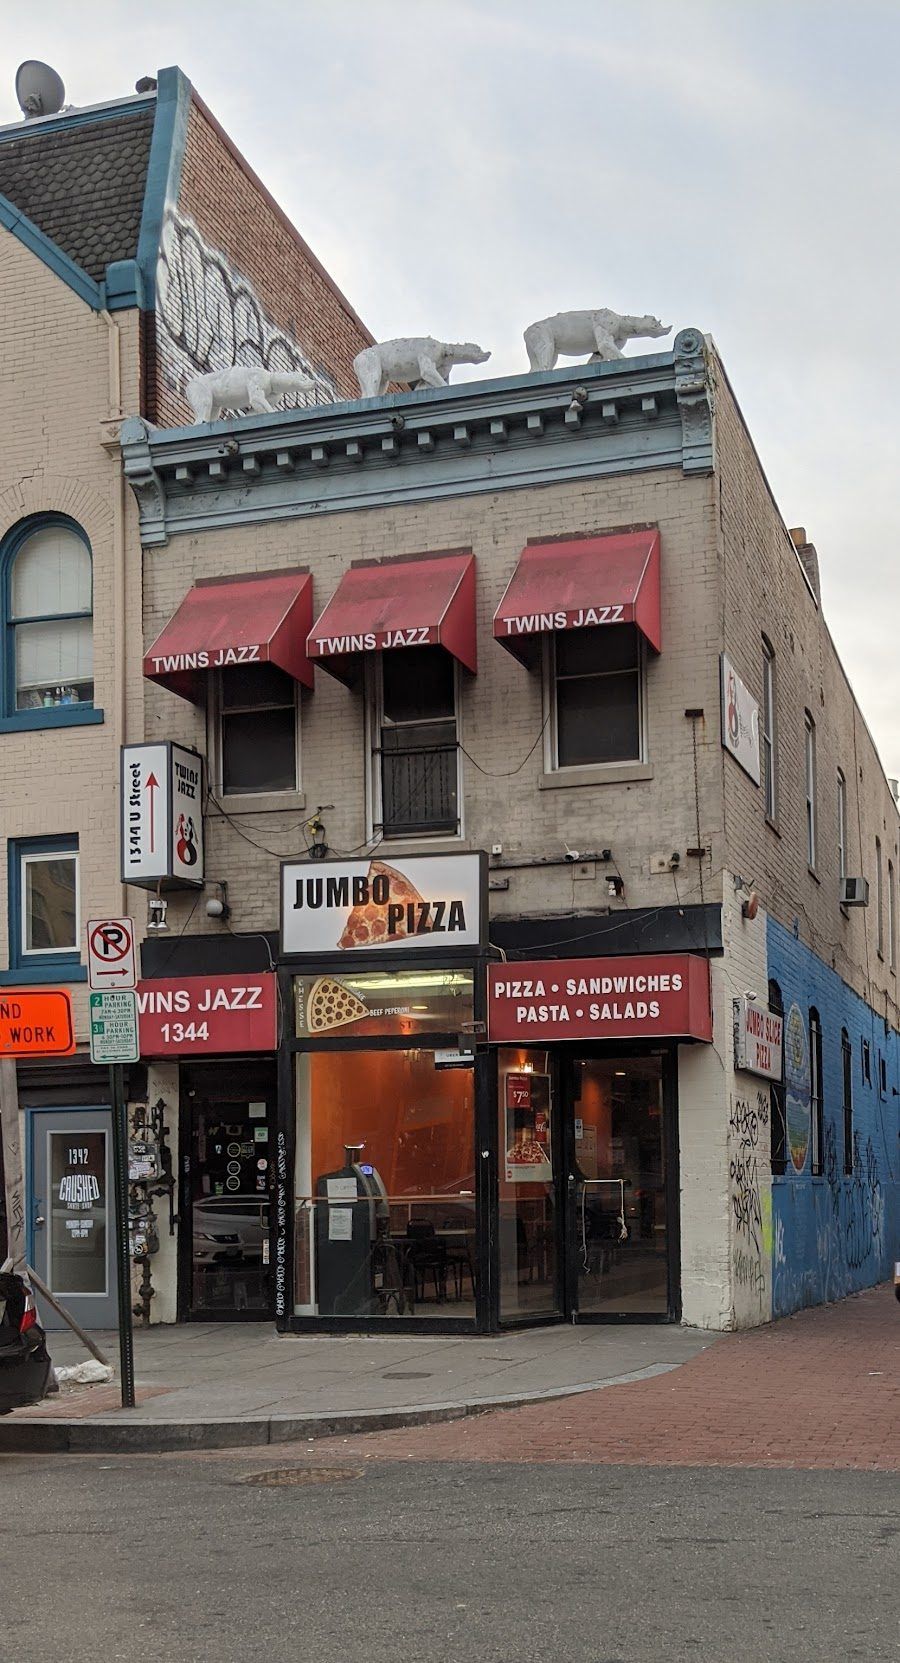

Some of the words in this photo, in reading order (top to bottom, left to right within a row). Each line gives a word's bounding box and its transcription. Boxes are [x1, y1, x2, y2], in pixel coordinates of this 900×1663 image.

[503, 612, 567, 634] TWINS
[573, 606, 624, 627] JAZZ
[316, 634, 376, 655] TWINS
[382, 627, 430, 648] JAZZ
[152, 652, 209, 673] TWINS
[215, 645, 260, 665] JAZZ
[129, 762, 141, 806] Street
[175, 762, 198, 785] TWINS
[177, 779, 195, 799] JAZZ
[130, 812, 141, 822] U
[130, 826, 141, 864] 1344
[293, 874, 390, 909] JUMBO
[388, 900, 466, 935] PIZZA
[198, 987, 262, 1011] JAZZ
[494, 980, 546, 998] PIZZA
[566, 974, 683, 996] SANDWICHES
[369, 1009, 383, 1017] BEEF
[517, 1005, 570, 1023] PASTA
[589, 1001, 660, 1020] SALADS
[746, 1007, 764, 1040] JUMBO
[10, 1026, 56, 1043] WORK
[161, 1022, 209, 1043] 1344
[756, 1042, 771, 1072] PIZZA
[69, 1148, 88, 1165] 1342
[59, 1174, 100, 1203] CRUSHED
